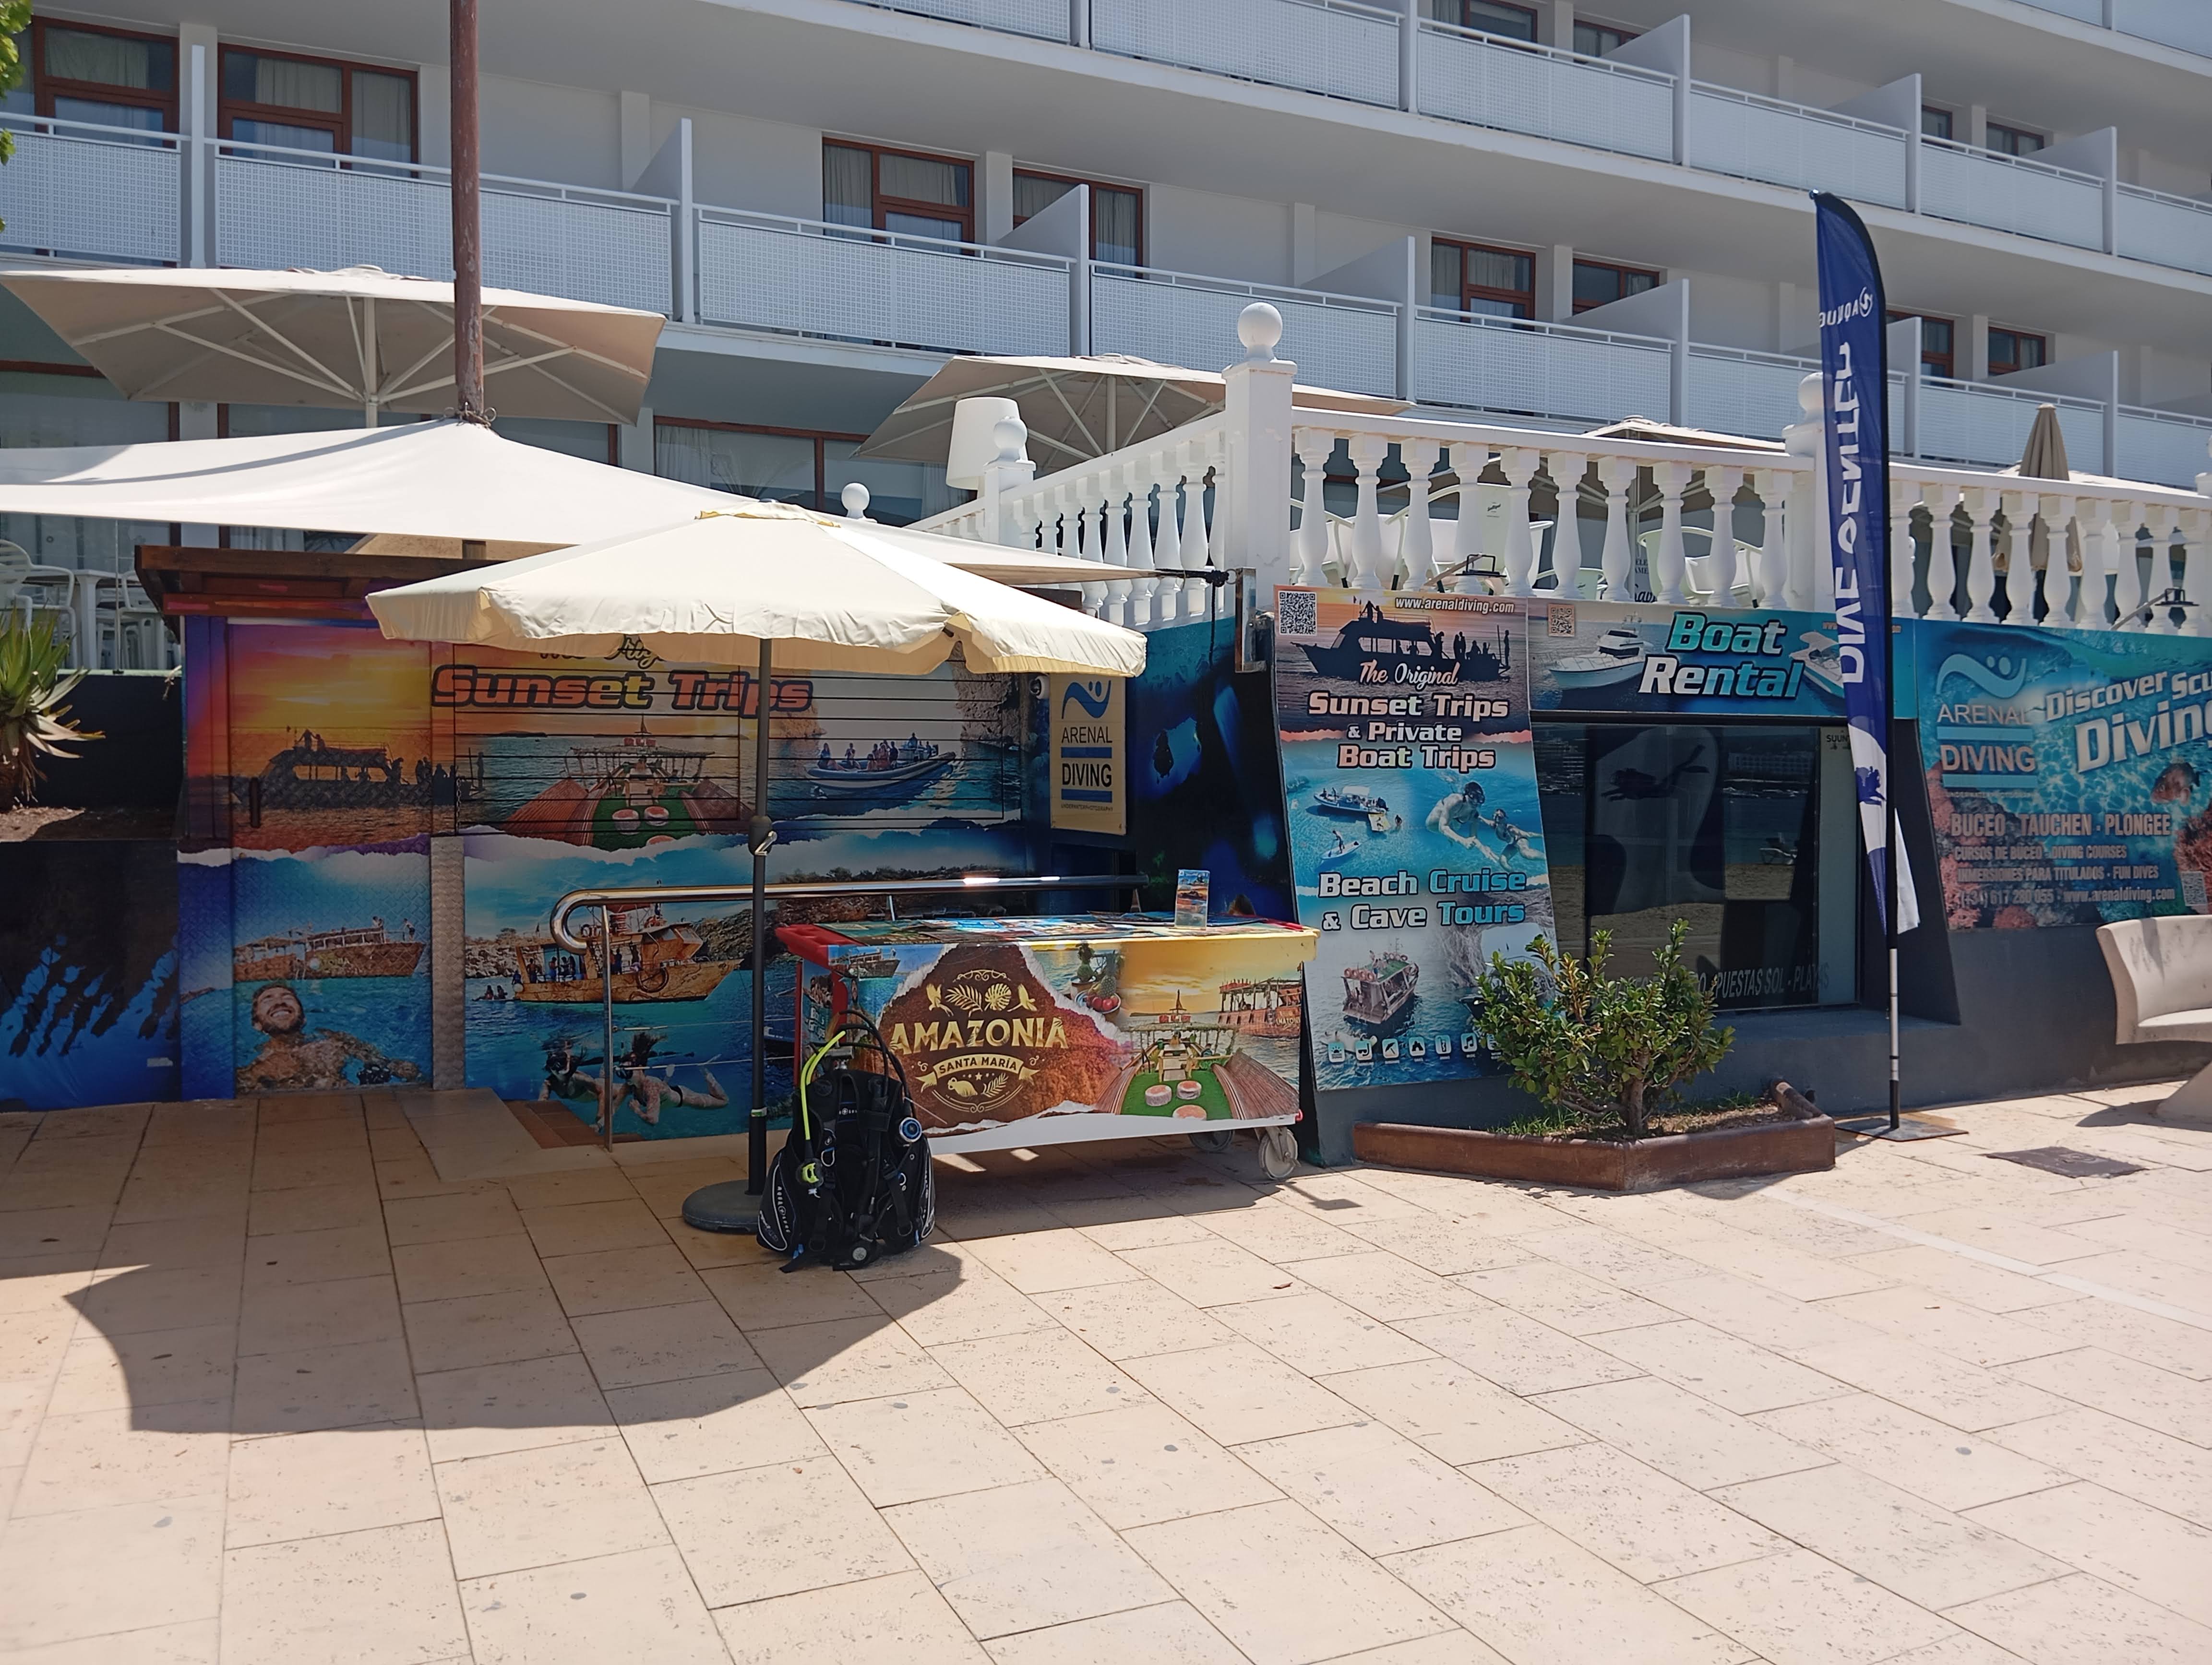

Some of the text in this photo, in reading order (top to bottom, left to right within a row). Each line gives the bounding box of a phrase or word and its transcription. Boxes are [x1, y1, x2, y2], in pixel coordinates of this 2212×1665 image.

[1395, 597, 1514, 614] www.arenaldiving.com
[1665, 611, 1787, 655] Boat
[1359, 659, 1460, 689] The Original
[1637, 654, 1805, 698] Rental
[431, 665, 813, 718] Sunset Trips
[2045, 671, 2168, 721] Discover
[1308, 691, 1509, 721] Sunset Trips
[1937, 704, 2033, 725] ARENAL
[1061, 726, 1112, 743] ARENAL
[1348, 721, 1461, 742] & Private
[1338, 744, 1495, 772] Boat Trips
[1940, 744, 2036, 772] DIVING
[1062, 763, 1112, 787] DIVING
[1951, 813, 2170, 836] BUCEO TAUCHEN PLONGEE
[1955, 845, 2127, 860] CURSOS DE BUCEO DIVING COURSES
[1318, 867, 1526, 898] Beach Cruise
[1957, 865, 2158, 882] INMERSIONES PARA TITULADOS FUN DIVES
[1991, 890, 2009, 904] 617
[2064, 887, 2175, 903] www.arenaldiving.com
[1322, 901, 1525, 930] & Cave Tours
[1715, 968, 1763, 999] PUESTAS
[1764, 967, 1784, 994] SOL
[889, 1017, 1069, 1055] AMAZONIA
[939, 1056, 1017, 1074] SANTA MARÍA
